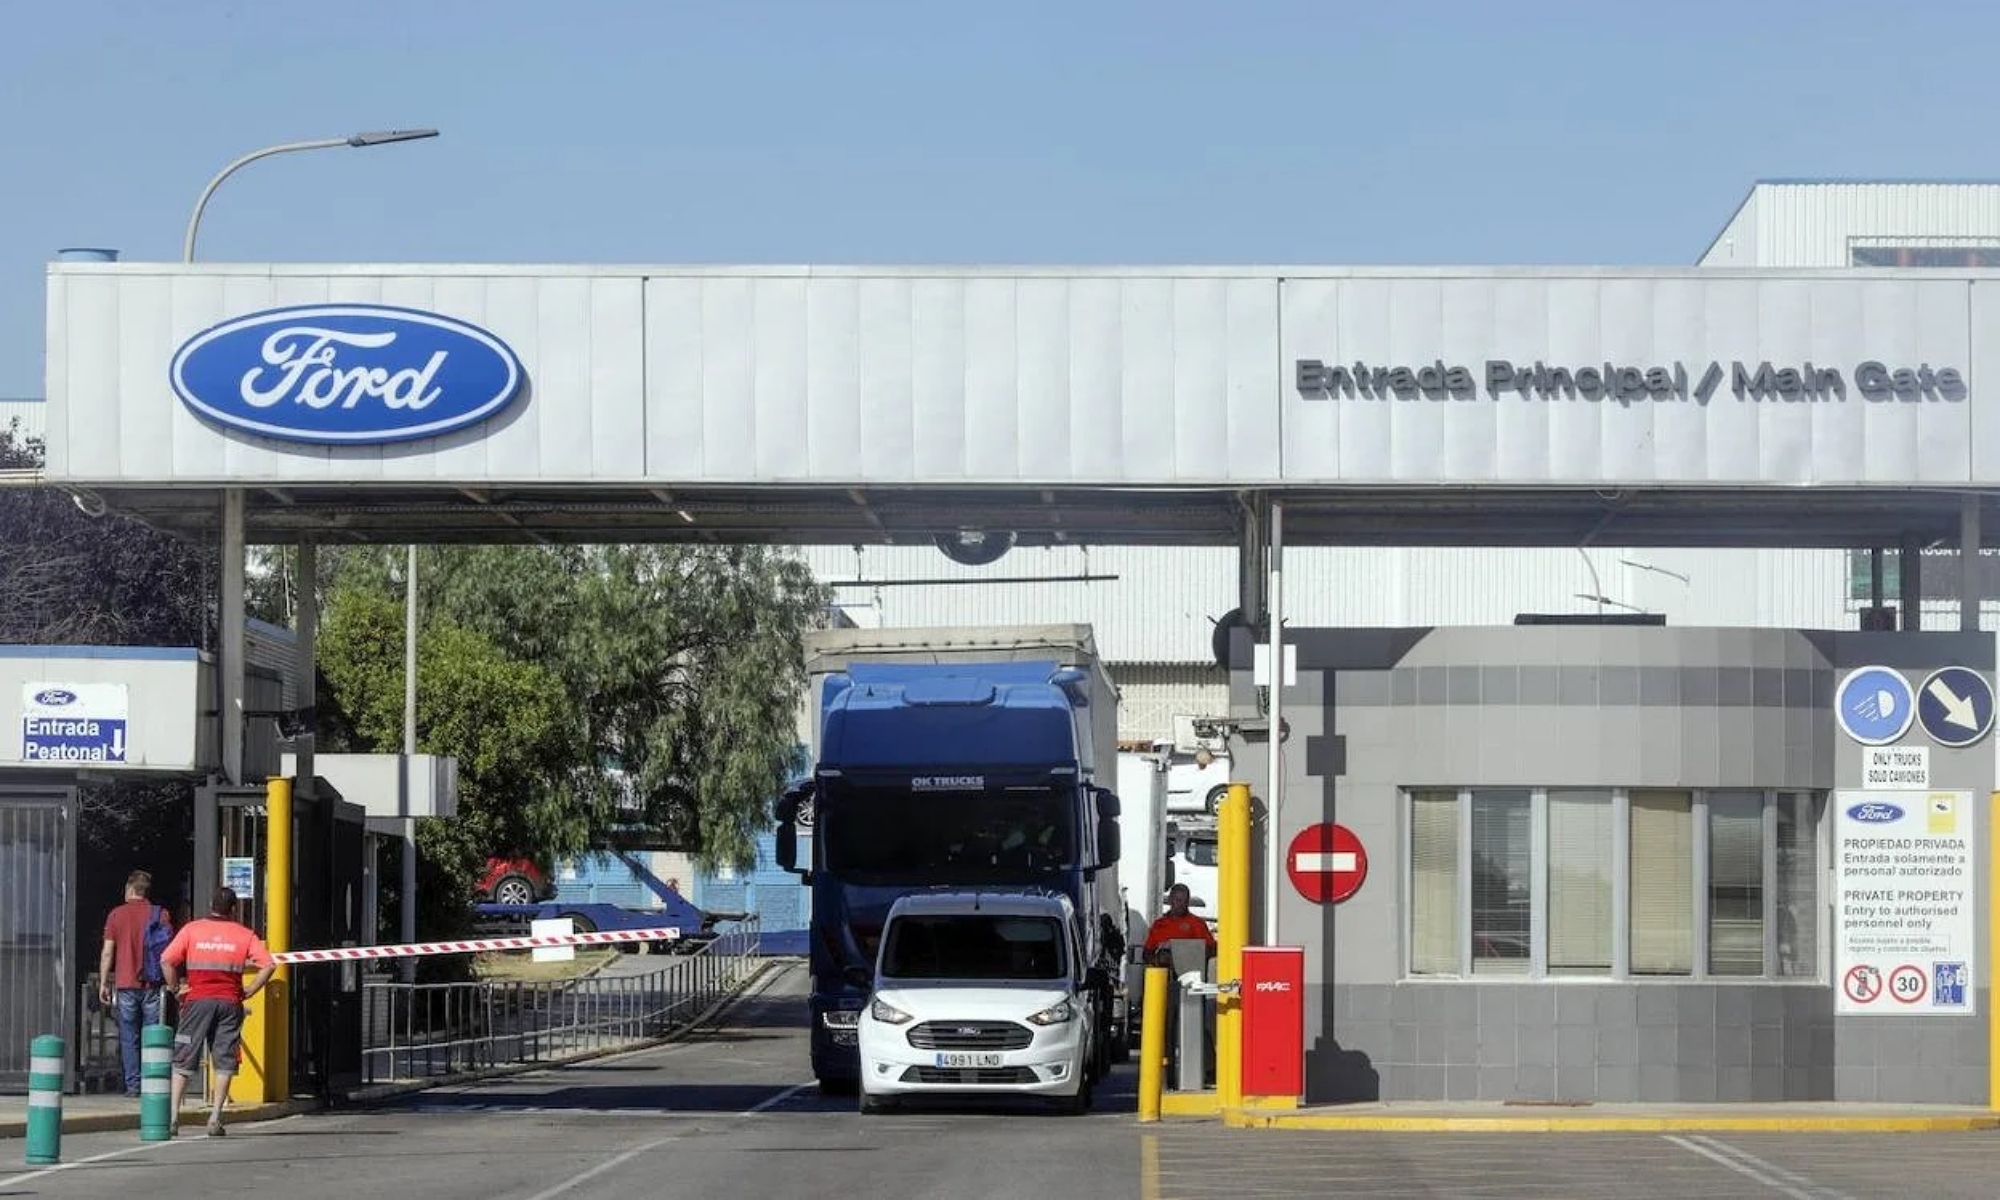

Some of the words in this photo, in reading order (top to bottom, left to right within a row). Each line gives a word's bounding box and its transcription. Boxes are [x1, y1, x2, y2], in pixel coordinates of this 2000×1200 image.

[240, 326, 449, 410] Ford
[1296, 359, 1475, 400] Entrada
[1485, 359, 1688, 408] Principal
[1693, 361, 1724, 406] /
[1732, 361, 1846, 401] Main
[1854, 360, 1966, 402] Gate
[26, 718, 100, 736] Entrada
[26, 741, 107, 761] Peatonal
[1873, 752, 1891, 766] ONLY
[1894, 752, 1922, 766] TRUCKS
[911, 776, 932, 787] OK
[934, 776, 984, 787] TRUCKS
[1868, 770, 1887, 783] SOLO
[1889, 770, 1926, 783] CAMIONES
[1844, 839, 1912, 849] PROPIEDAD
[1914, 839, 1965, 849] PRIVADA
[1844, 853, 1890, 863] Entrada
[1894, 853, 1955, 863] solamente
[1959, 855, 1965, 863] a
[1844, 866, 1896, 877] personal
[1898, 866, 1962, 876] autorizado
[1844, 890, 1894, 901] PRIVATE
[1898, 890, 1963, 901] PROPERTY
[1844, 905, 1876, 917] Entry
[1879, 905, 1891, 915] to
[1894, 905, 1958, 915] authorised
[1844, 919, 1903, 929] personnel
[1906, 919, 1932, 930] only
[1897, 977, 1919, 992] 30
[944, 1054, 973, 1066] 4991
[976, 1054, 999, 1066] LND
